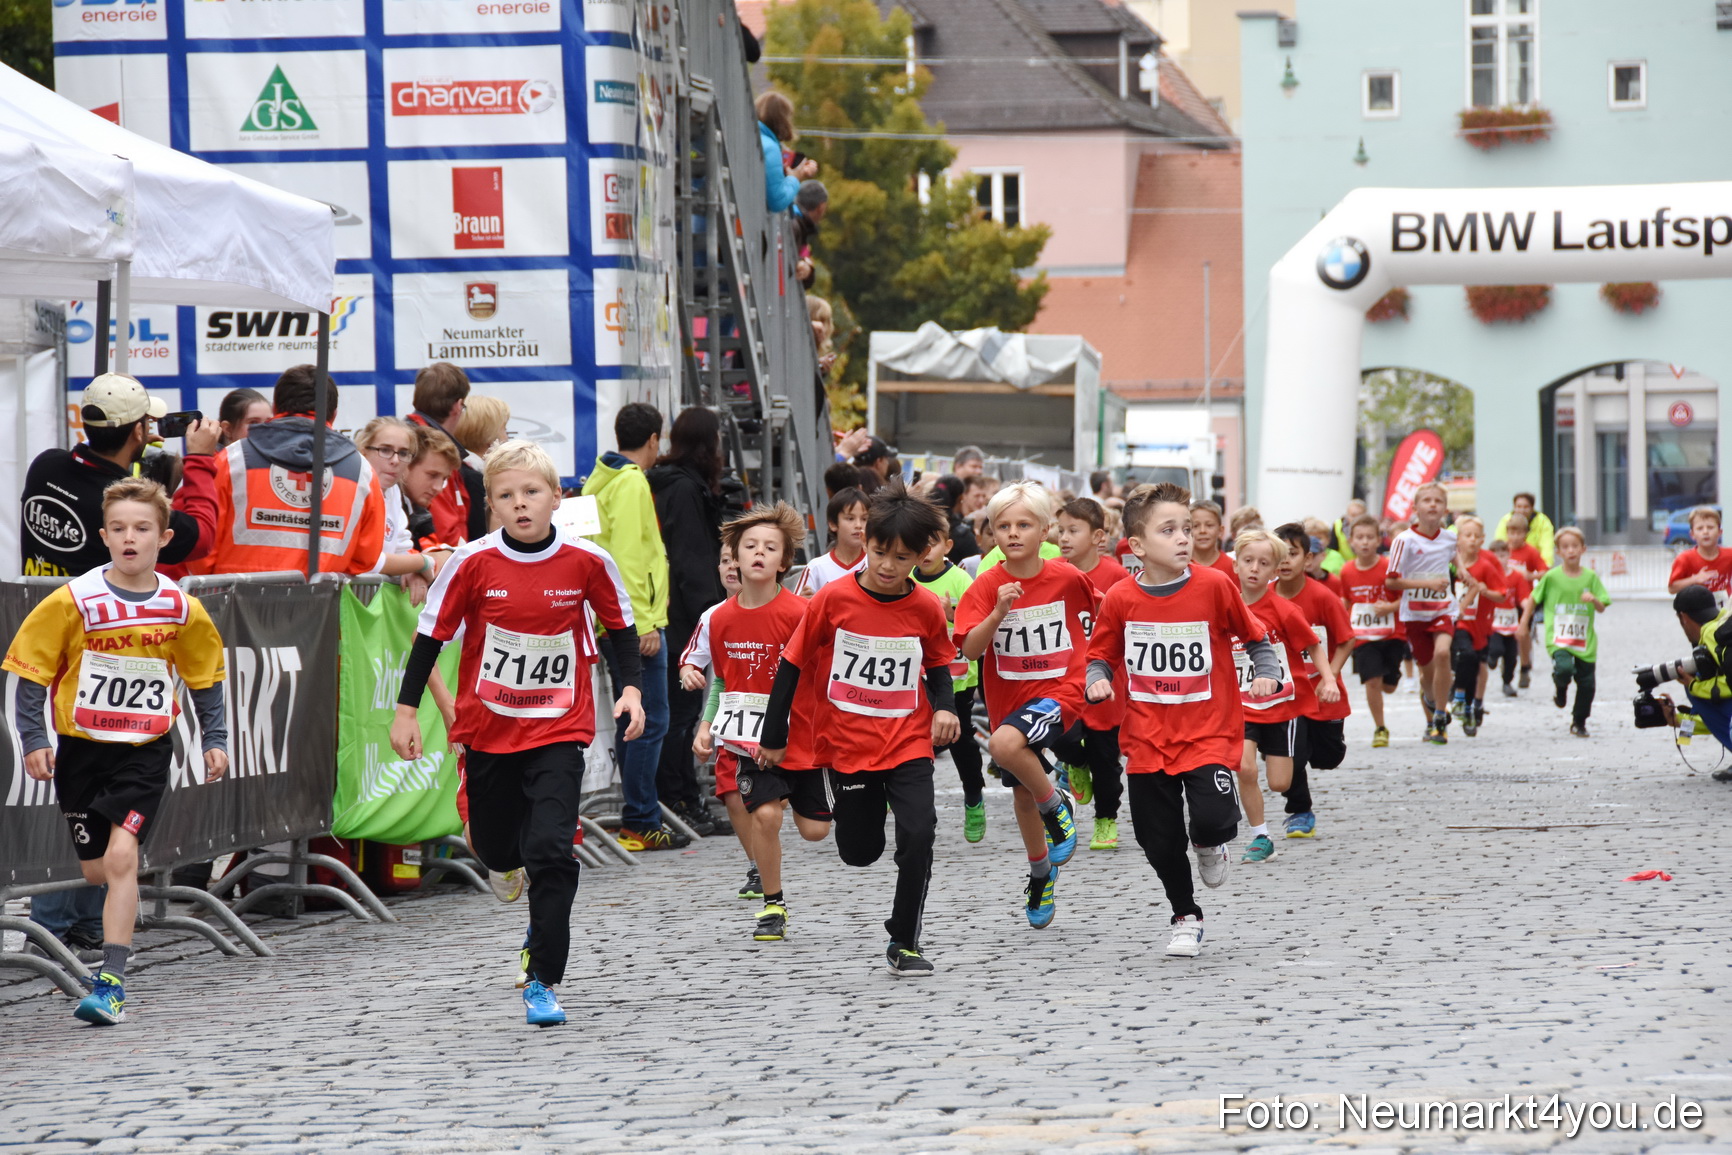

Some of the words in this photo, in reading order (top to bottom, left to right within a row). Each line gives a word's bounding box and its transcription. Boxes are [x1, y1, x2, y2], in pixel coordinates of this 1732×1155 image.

[82, 3, 157, 23] energie
[477, 0, 550, 15] energie
[397, 82, 513, 107] charivari
[453, 212, 500, 235] Braun
[1391, 211, 1537, 253] BMW
[1552, 206, 1732, 256] Laufsp
[206, 311, 310, 338] swn
[443, 326, 524, 340] Neumarkter
[205, 341, 274, 352] stadtwerke
[428, 340, 539, 359] Lammsbräu
[1387, 440, 1437, 518] REWE
[275, 476, 298, 502] ROTES
[29, 500, 80, 542] Hervis
[31, 524, 55, 539] SPORTS
[486, 589, 508, 597] JAKO
[550, 599, 577, 609] Johannes
[1024, 606, 1059, 620] BOCK
[998, 620, 1063, 653] 7117
[1161, 625, 1203, 636] BOCK
[87, 634, 134, 651] MAX
[527, 636, 570, 648] BOCK
[875, 640, 916, 651] BOCK
[1022, 659, 1049, 670] Silas
[1133, 641, 1205, 673] 7068
[124, 660, 166, 672] BOCK
[493, 647, 569, 685] 7149
[843, 650, 912, 687] 7431
[89, 673, 165, 710] 7023
[1155, 680, 1181, 692] Paul
[495, 689, 554, 706] Johannes
[92, 714, 151, 731] Leonhard
[720, 710, 765, 738] 717
